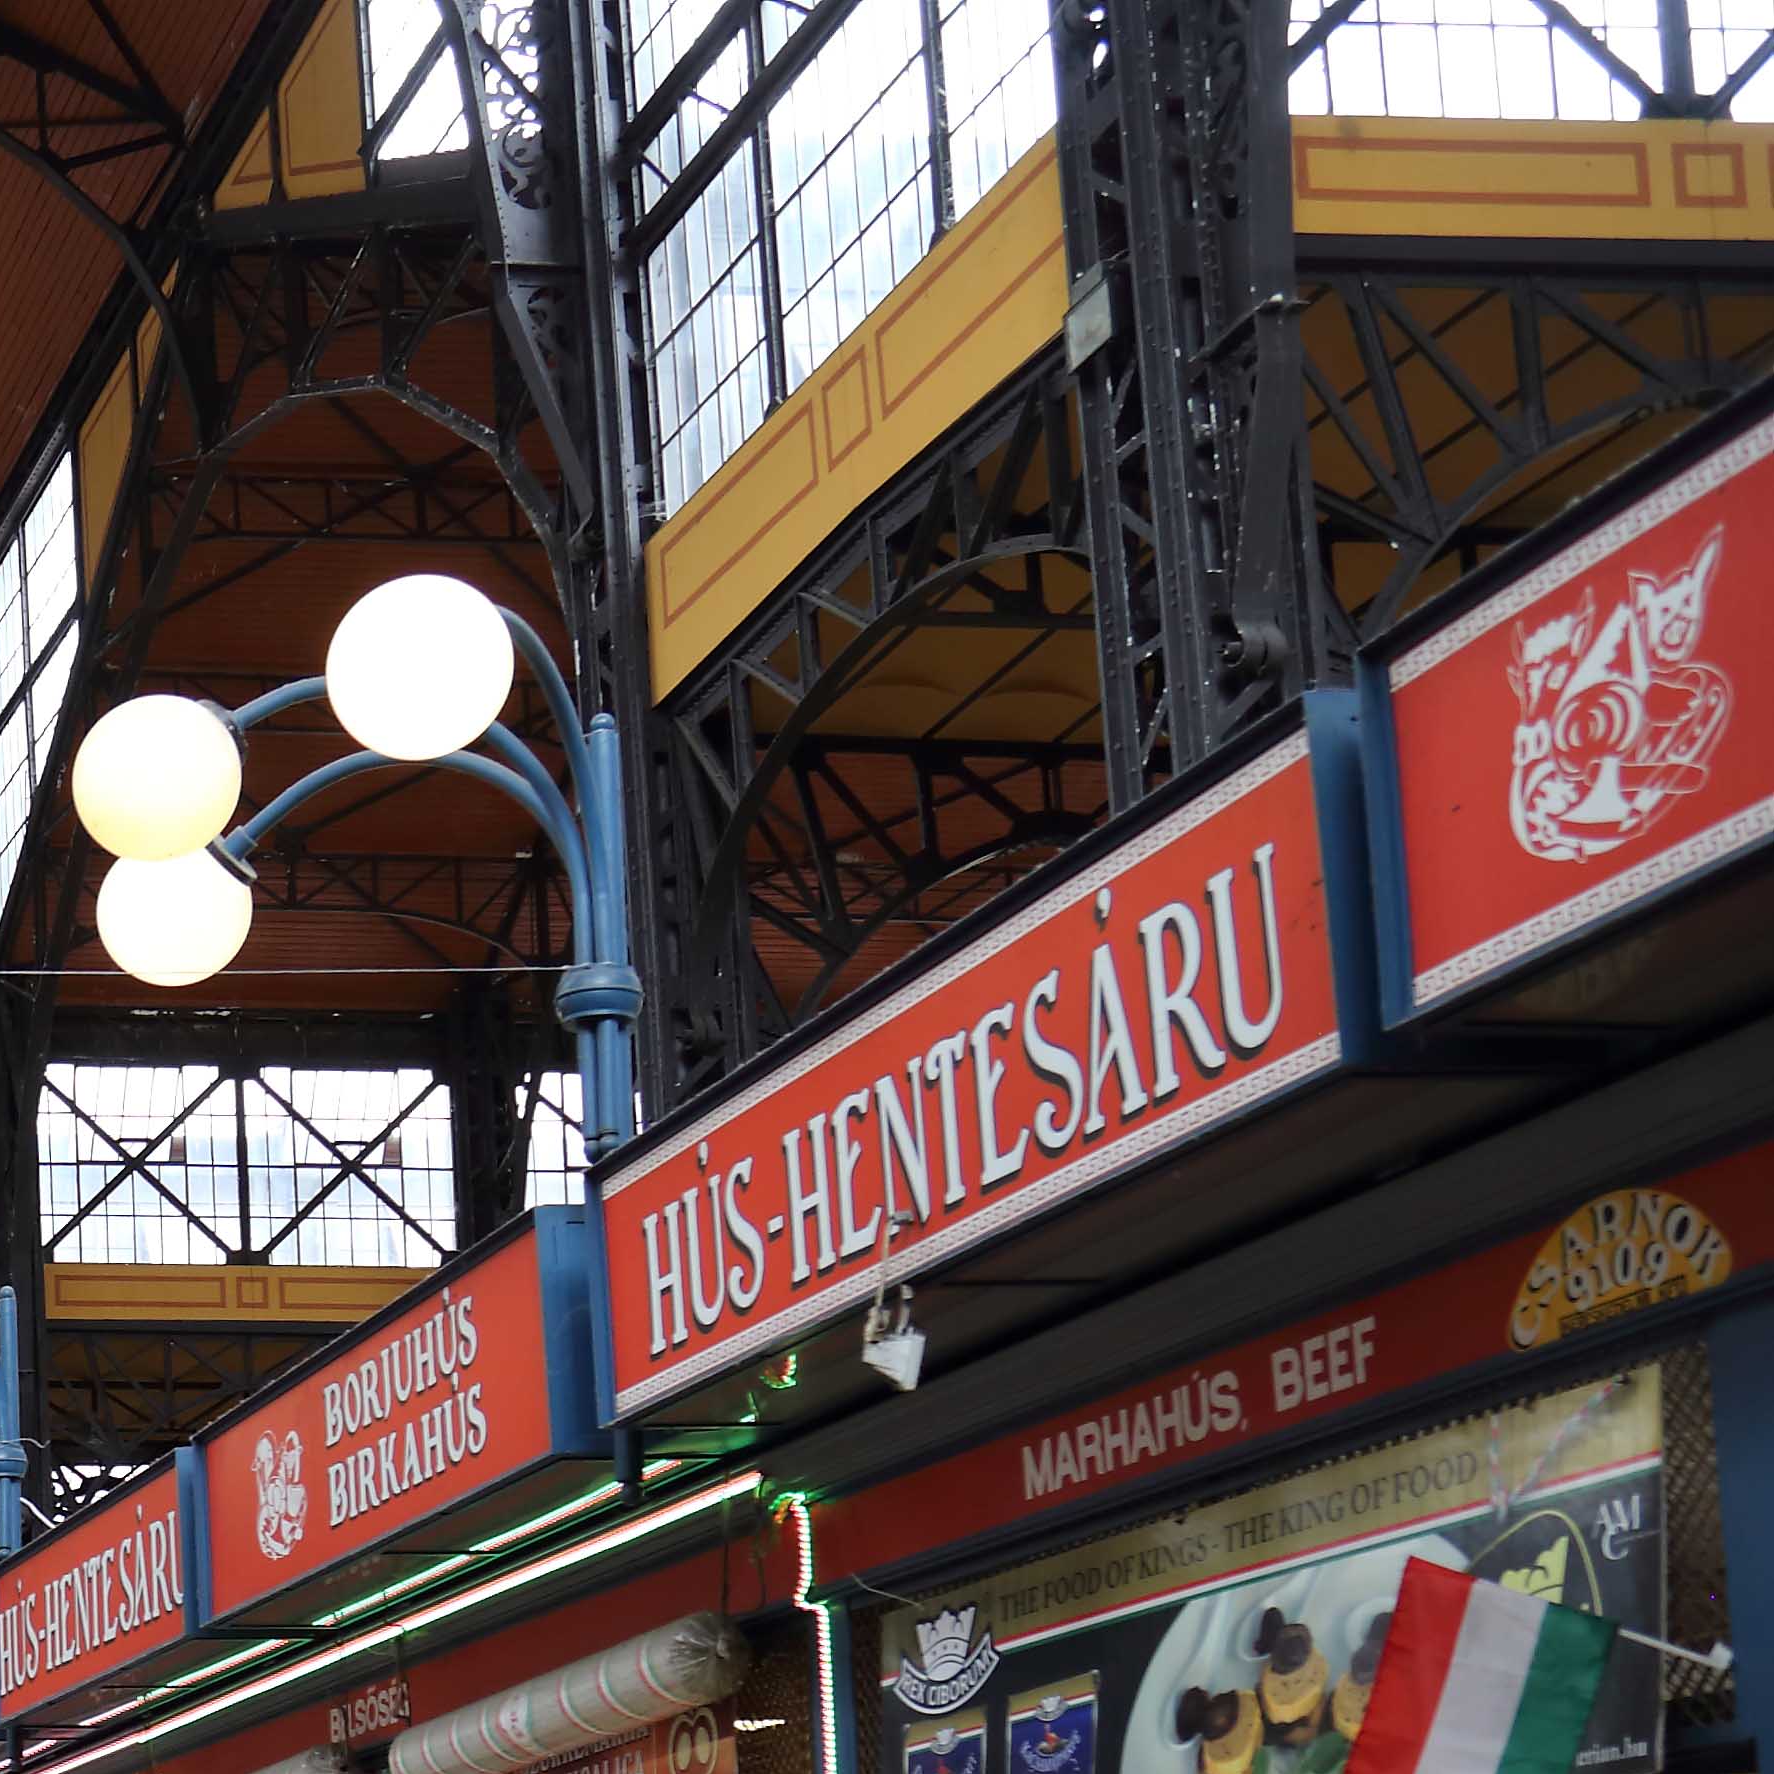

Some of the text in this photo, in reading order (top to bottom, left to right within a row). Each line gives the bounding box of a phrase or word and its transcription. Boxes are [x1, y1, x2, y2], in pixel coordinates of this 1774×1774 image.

[642, 842, 1285, 1357] HÚS-HENTESÁRU
[1512, 1192, 1726, 1348] CSARNOK
[323, 1286, 478, 1447] BORJUHÚS
[1021, 1316, 1376, 1500] MARHAHÚS, BEEF
[327, 1371, 488, 1527] BIRKAHÚS
[1000, 1583, 1040, 1624] THE
[1044, 1564, 1102, 1607] FOOD
[1103, 1554, 1136, 1592] OF
[1138, 1534, 1207, 1581] KINGS
[1222, 1510, 1272, 1553] THE
[1278, 1490, 1345, 1538] KING
[1352, 1473, 1389, 1514] OF
[1392, 1451, 1478, 1504] FOOD
[901, 1652, 993, 1706] REX CIBORUM
